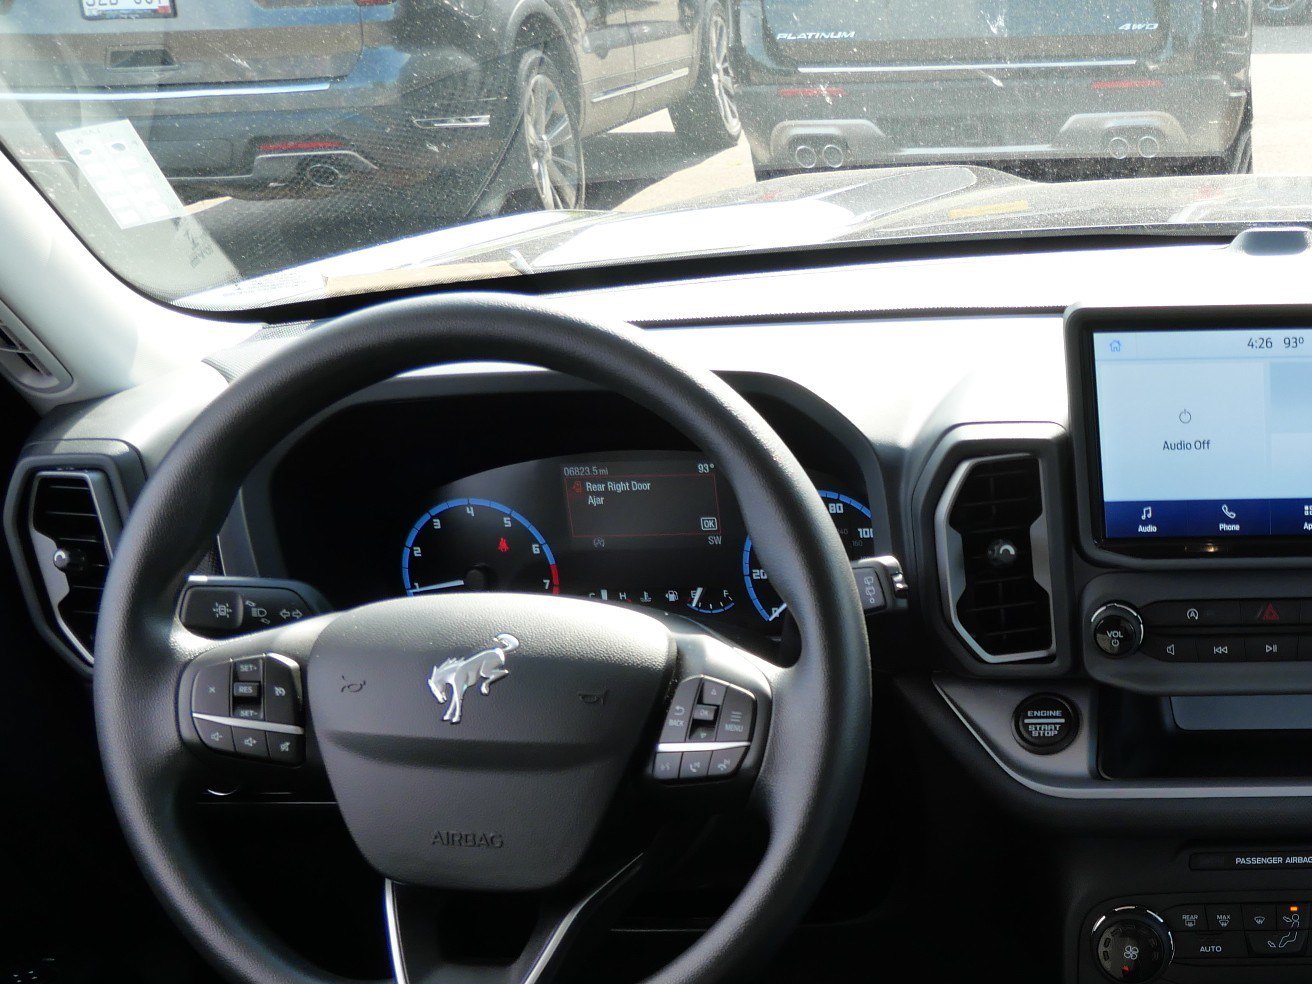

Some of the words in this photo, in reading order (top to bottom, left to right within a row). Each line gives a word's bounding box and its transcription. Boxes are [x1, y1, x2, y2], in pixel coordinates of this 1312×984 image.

[1118, 23, 1159, 31] 4WD
[776, 31, 856, 40] PLATINUM
[1247, 337, 1273, 349] 4:26
[1162, 440, 1192, 451] Audio
[1194, 439, 1211, 451] Off
[586, 481, 606, 492] Rear
[607, 480, 630, 494] Right
[631, 481, 651, 492] Door
[588, 495, 605, 507] Ajar
[466, 506, 475, 517] 4
[828, 503, 844, 514] 80
[433, 519, 441, 529] 3
[503, 517, 512, 527] 5
[703, 518, 716, 529] OK
[1219, 522, 1240, 532] Phone
[1138, 524, 1157, 533] Audio
[708, 535, 722, 545] SW
[413, 547, 422, 557] 2
[532, 544, 541, 554] 6
[752, 569, 768, 580] 20
[543, 579, 551, 590] 7
[619, 591, 627, 600] H
[723, 589, 731, 598] F
[1106, 630, 1124, 639] VOL
[239, 685, 253, 694] RES
[668, 718, 684, 728] BACK
[725, 723, 744, 733] MENU
[431, 831, 504, 849] AIRBAG
[1235, 857, 1283, 865] PASSENGER
[1199, 945, 1222, 953] AUTO
